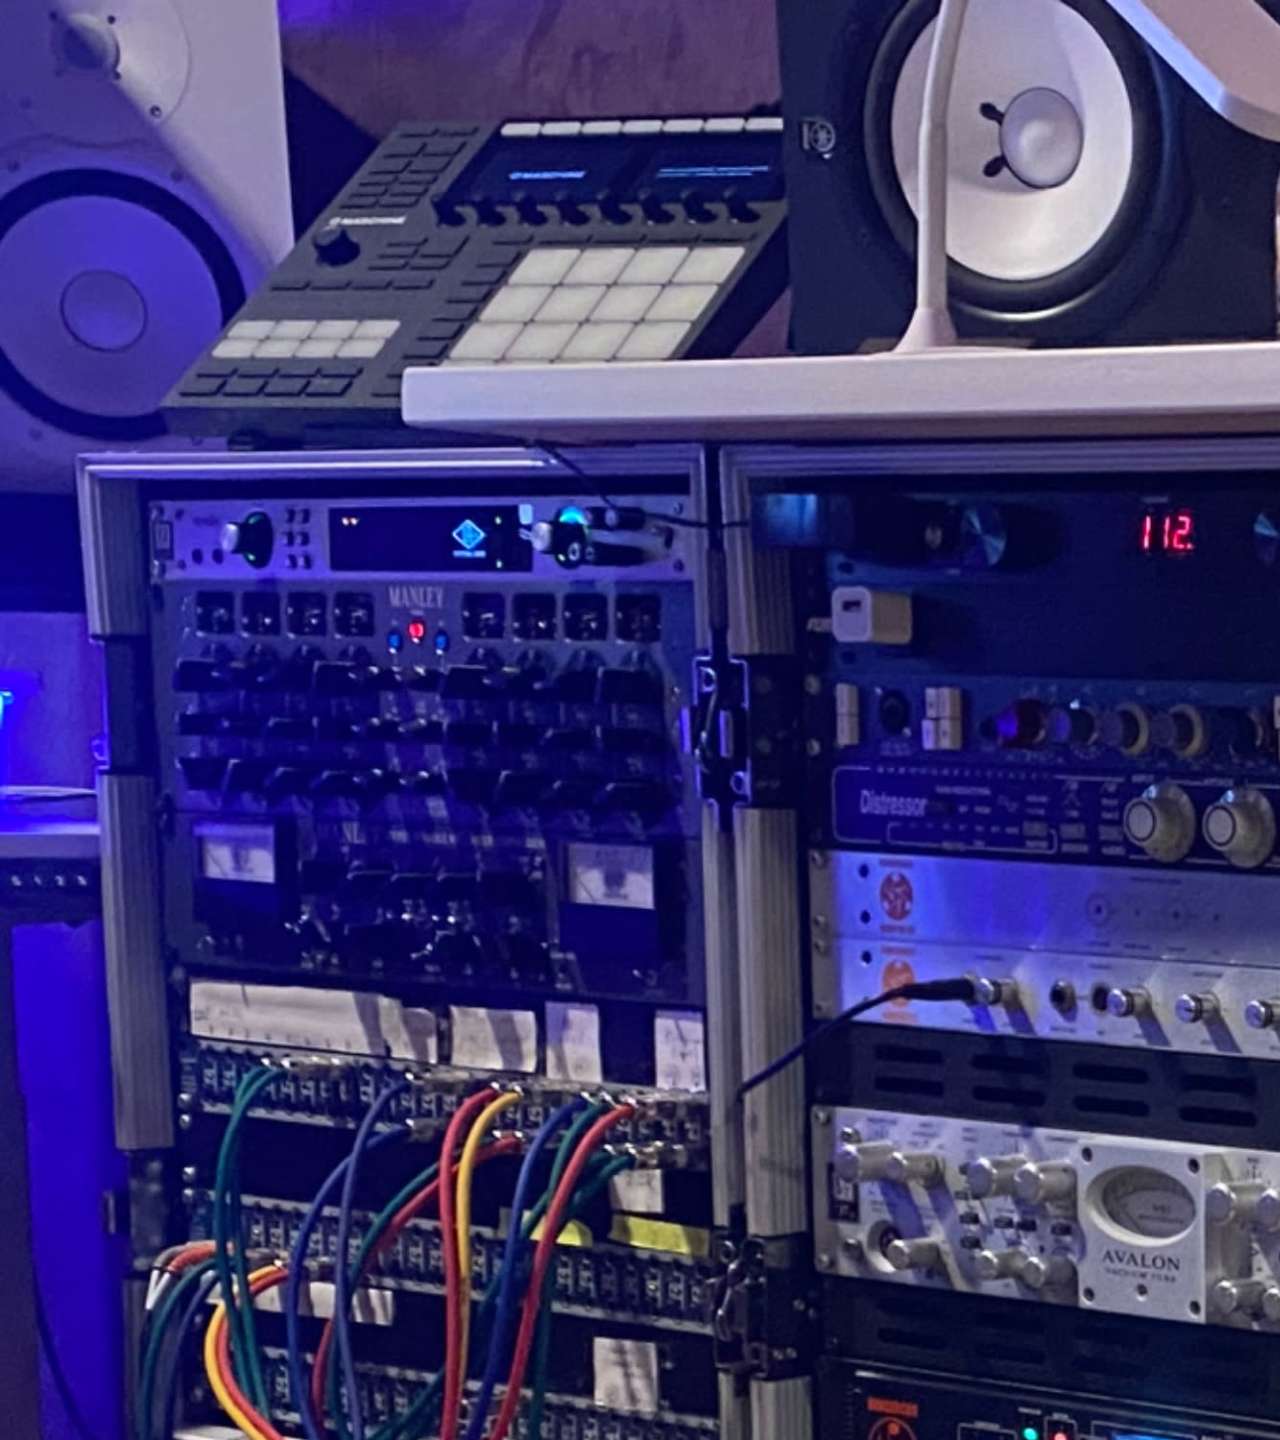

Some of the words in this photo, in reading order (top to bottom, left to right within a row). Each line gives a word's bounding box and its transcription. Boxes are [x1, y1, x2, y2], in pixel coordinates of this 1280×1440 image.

[388, 585, 444, 609] MANLEY
[859, 789, 929, 819] Distressor
[1102, 1248, 1181, 1272] AVALON
